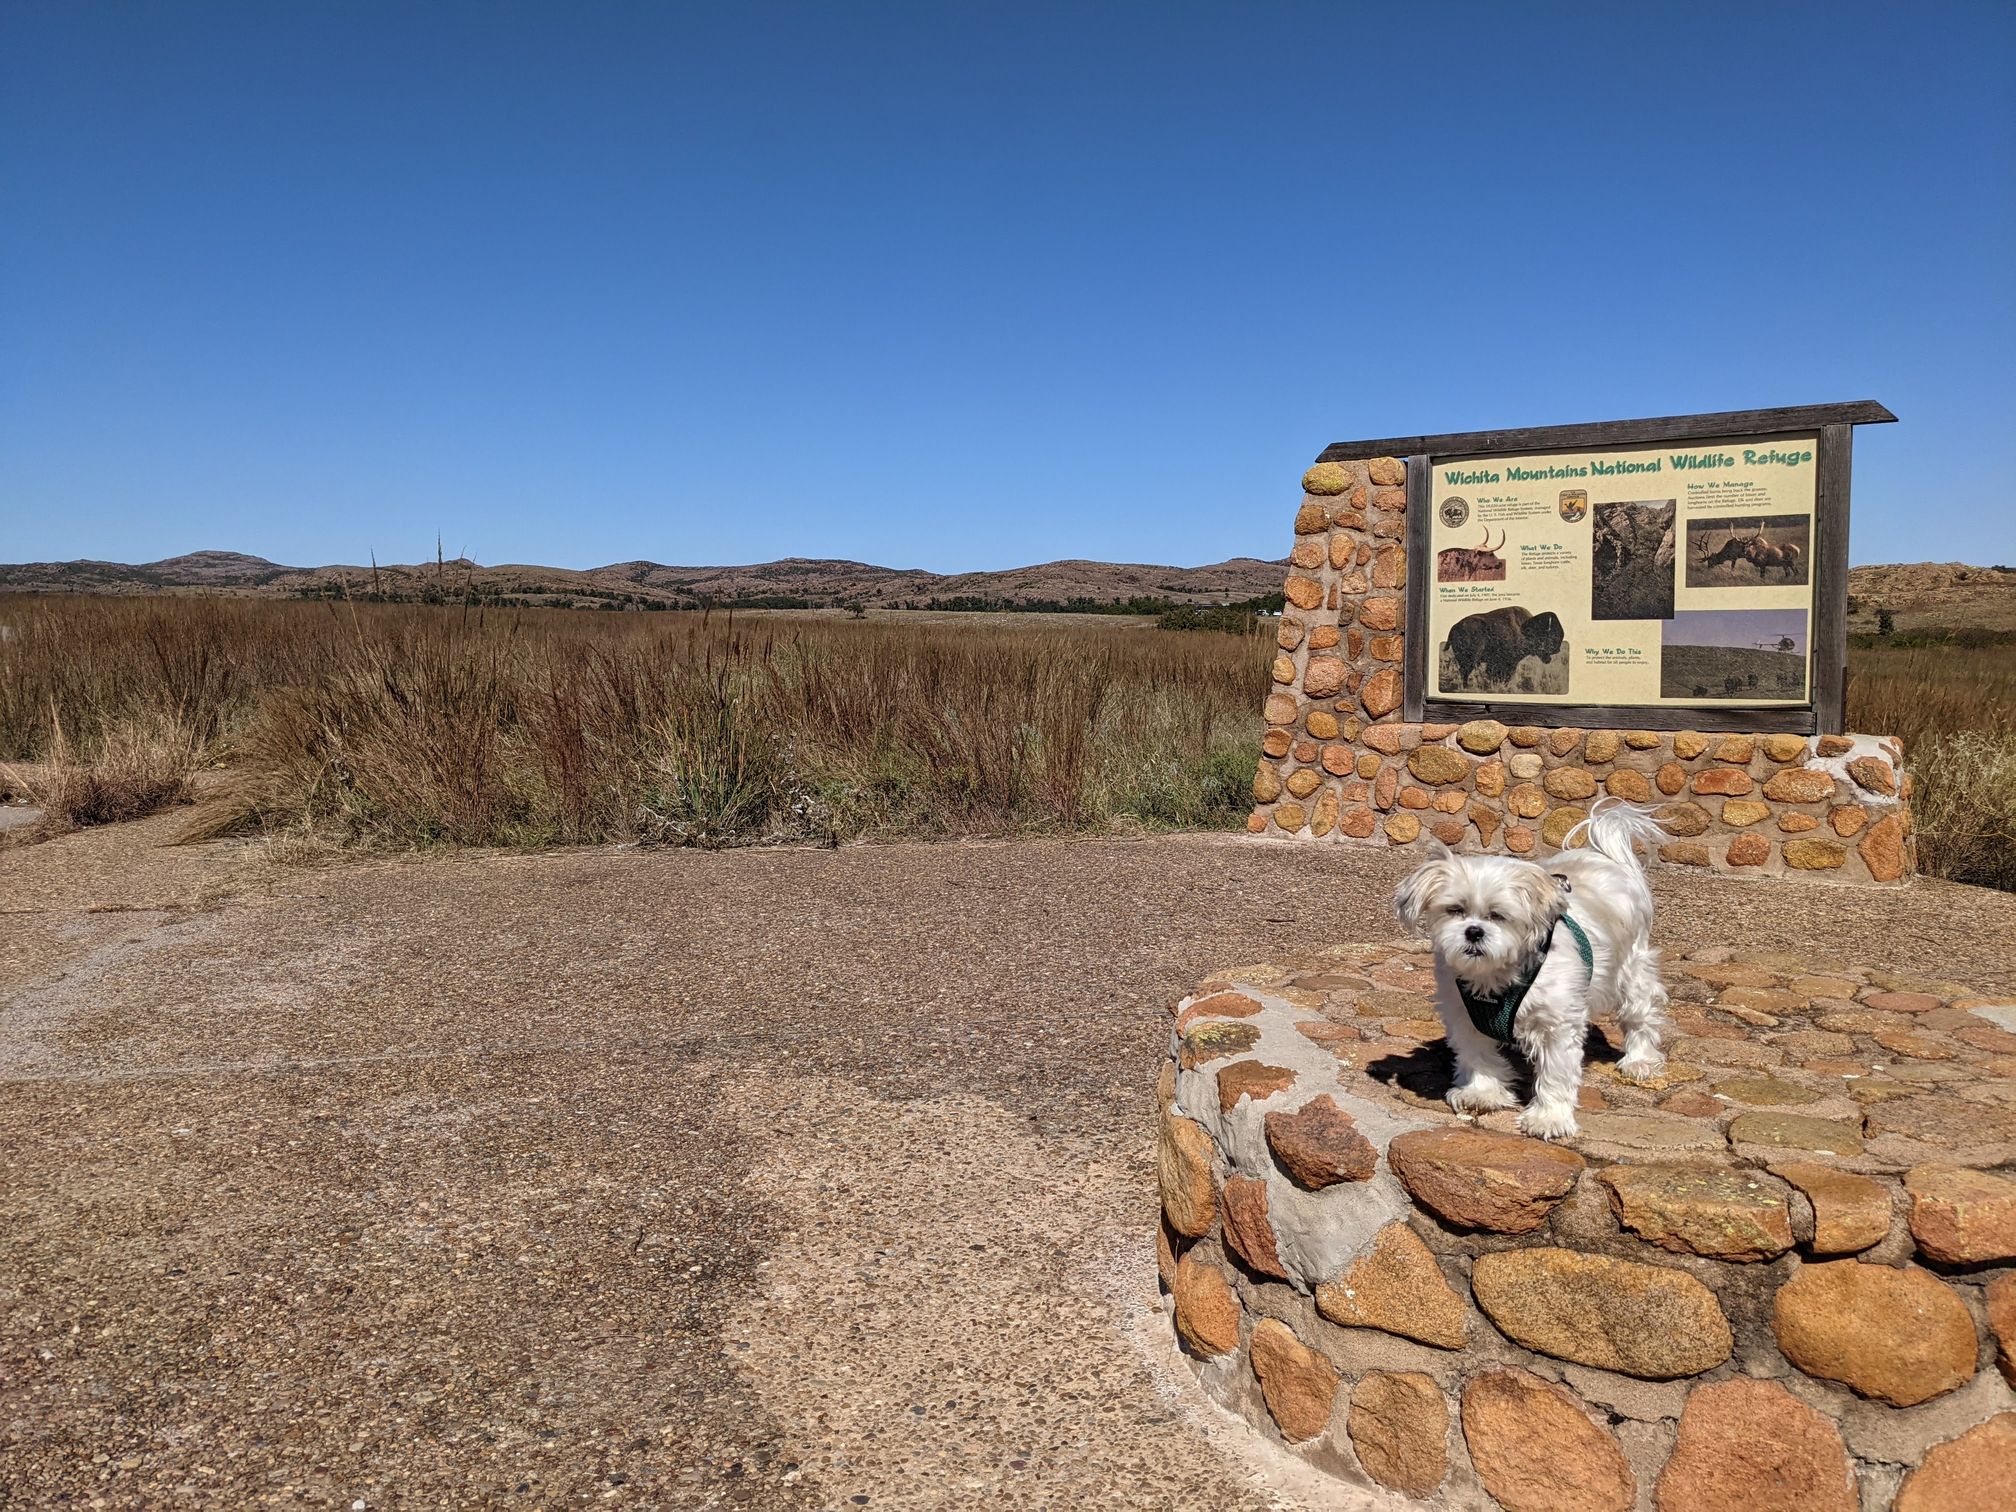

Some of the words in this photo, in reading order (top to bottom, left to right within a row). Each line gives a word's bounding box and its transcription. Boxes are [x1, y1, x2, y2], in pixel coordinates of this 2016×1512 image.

[1445, 470, 1500, 486] Wichita
[1506, 465, 1587, 482] Mountains
[1590, 458, 1662, 476] National
[1669, 453, 1735, 471] Wildlife
[1742, 449, 1812, 467] Refuge
[1585, 648, 1599, 656] Why
